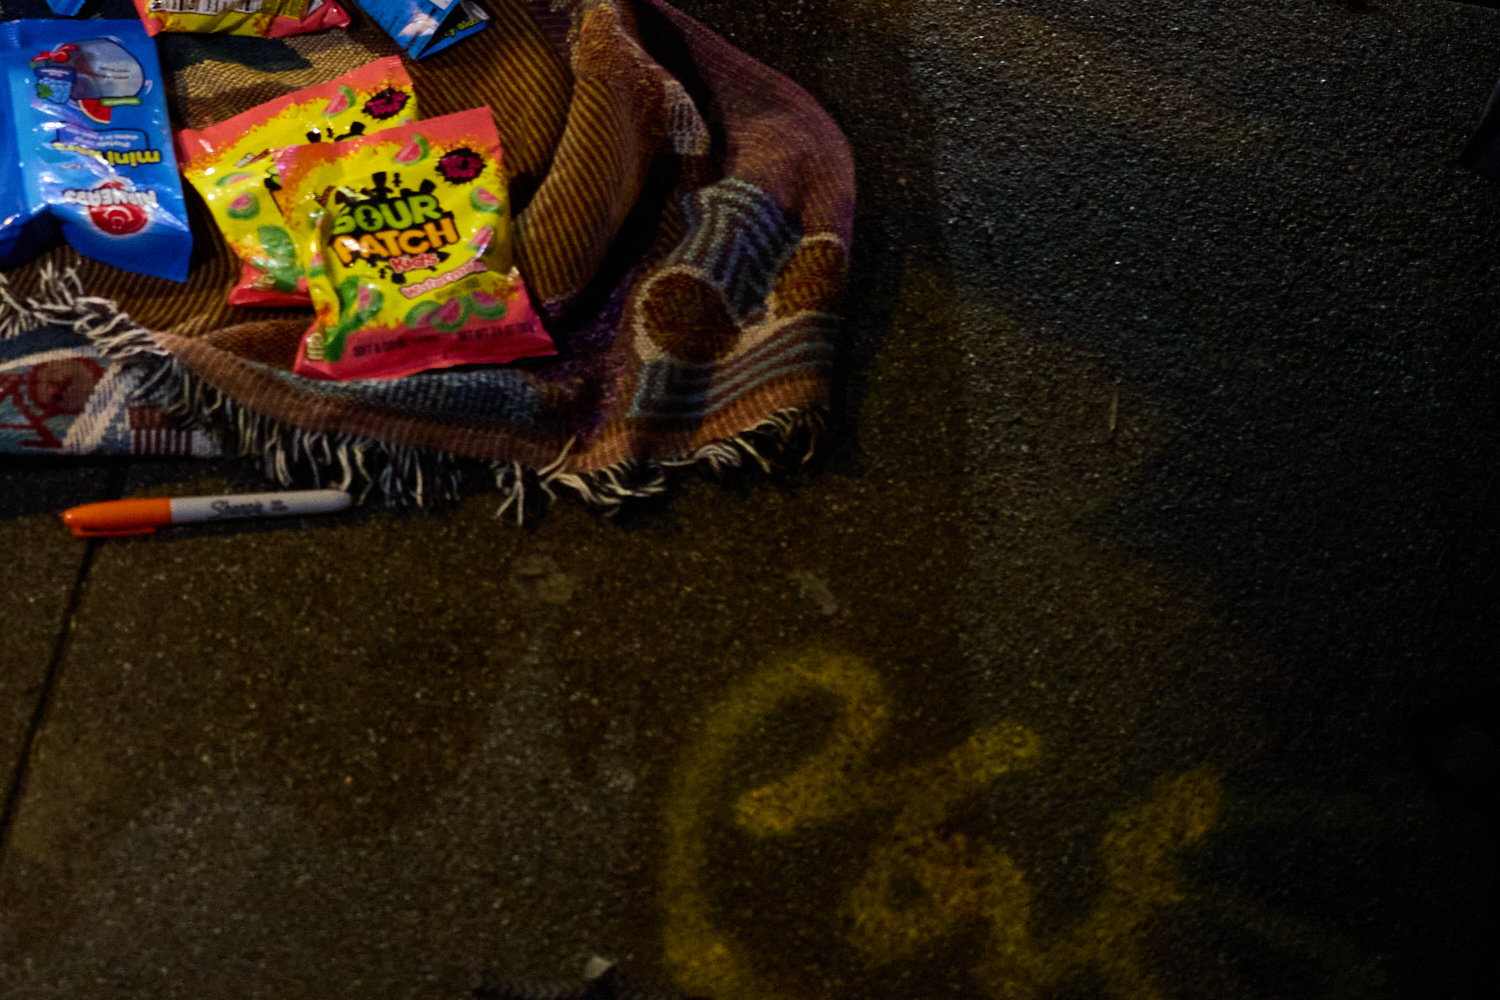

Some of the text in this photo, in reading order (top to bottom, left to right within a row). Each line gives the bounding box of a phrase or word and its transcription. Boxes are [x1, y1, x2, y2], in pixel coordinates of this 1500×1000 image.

[106, 150, 162, 167] mini
[334, 194, 442, 235] SOUR
[330, 216, 460, 264] PATCH
